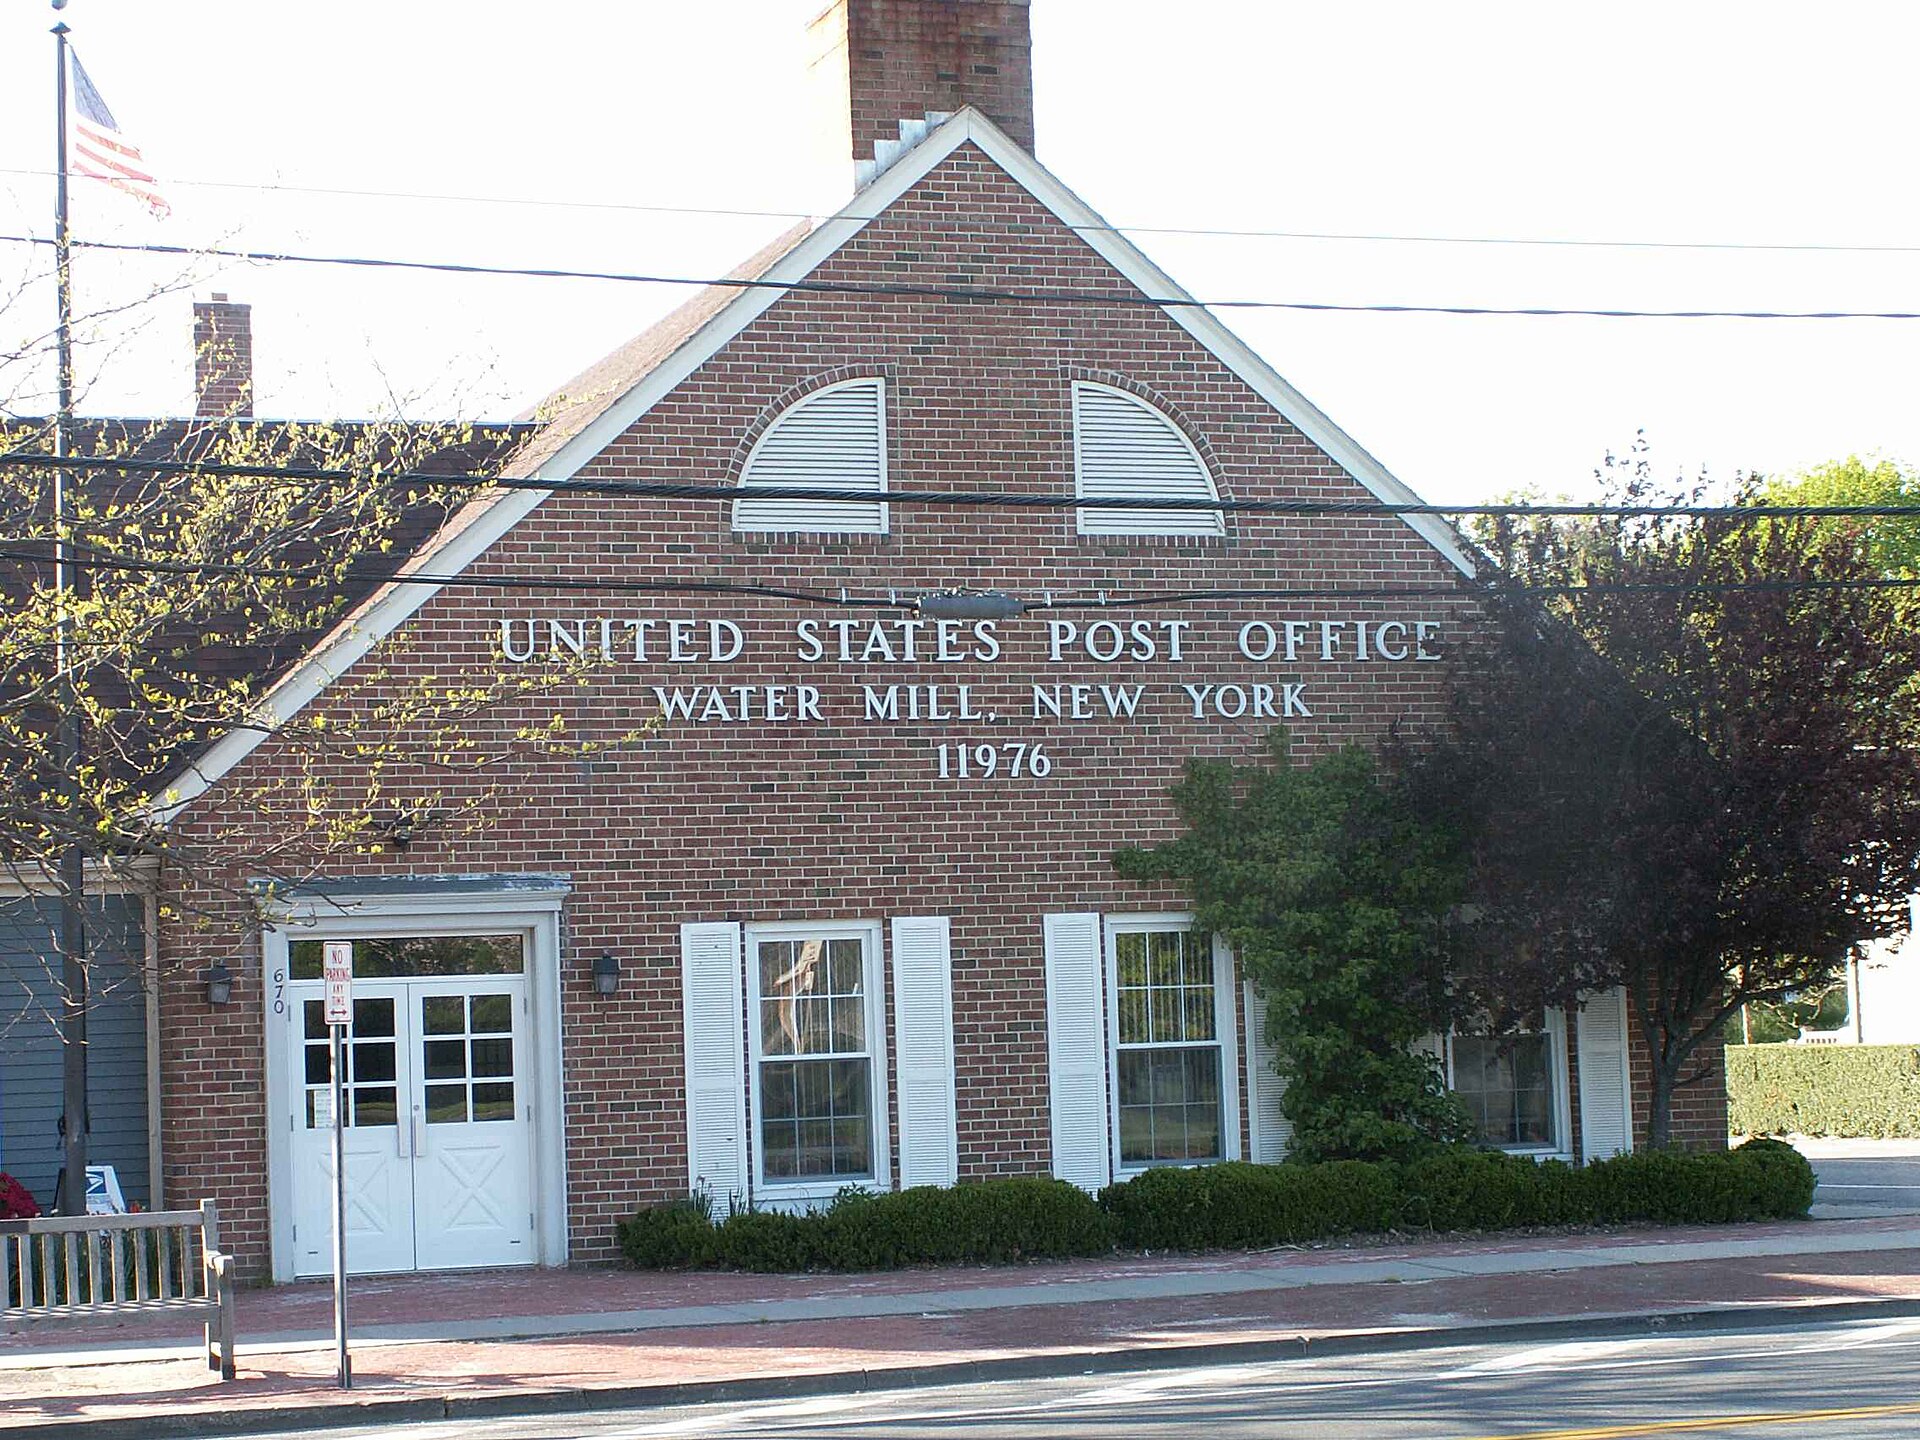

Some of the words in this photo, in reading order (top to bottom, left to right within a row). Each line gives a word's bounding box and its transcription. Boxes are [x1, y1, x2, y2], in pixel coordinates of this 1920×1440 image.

[497, 618, 744, 663] UNITED
[797, 619, 1001, 663] STATES
[1048, 620, 1190, 662] POST
[1238, 620, 1443, 662] OFFICE
[652, 685, 825, 722] WATER
[863, 685, 997, 724] MILL,
[1032, 684, 1146, 720] NEW
[1183, 683, 1314, 720] YORK
[937, 742, 1052, 780] 11976
[325, 967, 350, 982] PARKING
[332, 950, 343, 964] NO
[274, 969, 284, 1014] 670
[333, 984, 343, 994] ANY
